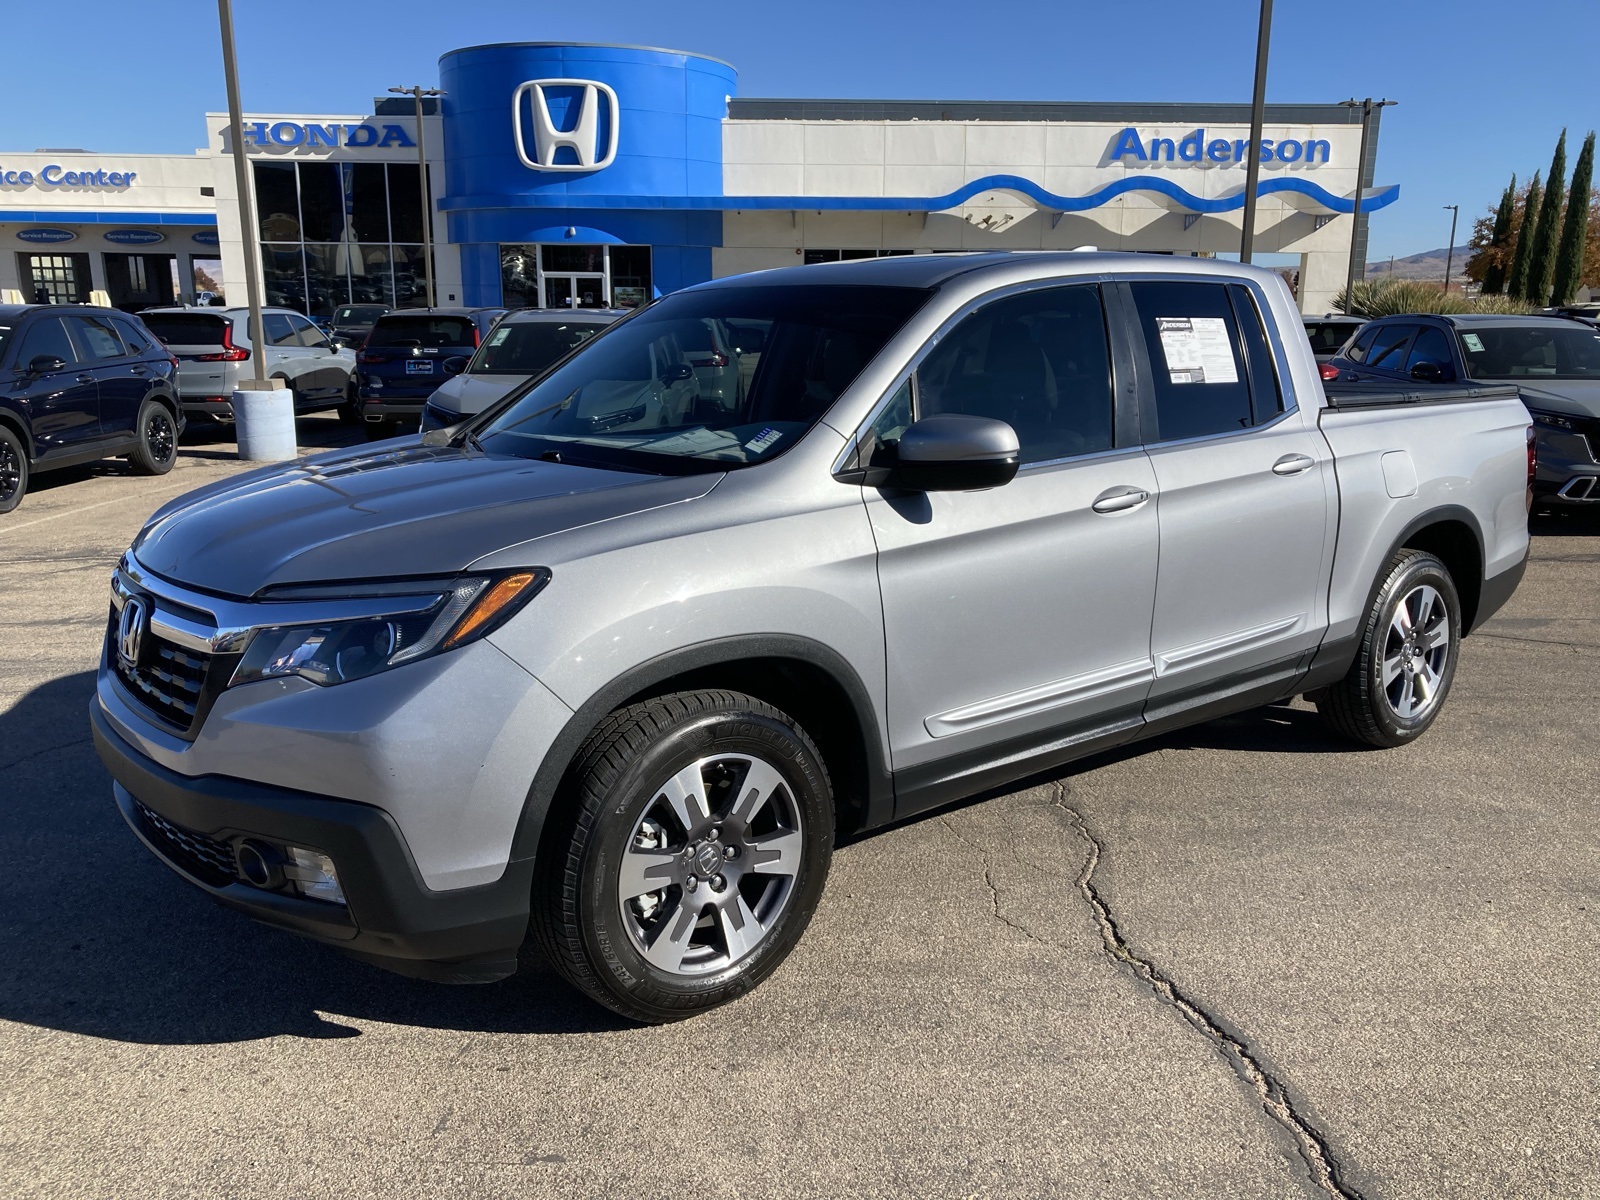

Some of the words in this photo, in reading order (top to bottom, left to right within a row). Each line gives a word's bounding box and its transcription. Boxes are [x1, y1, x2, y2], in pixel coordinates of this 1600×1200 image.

[243, 121, 416, 148] HONDA
[1111, 127, 1331, 163] Anderson
[42, 165, 136, 187] Center
[715, 722, 797, 758] MICHELIN
[594, 921, 634, 988] 245/60R18
